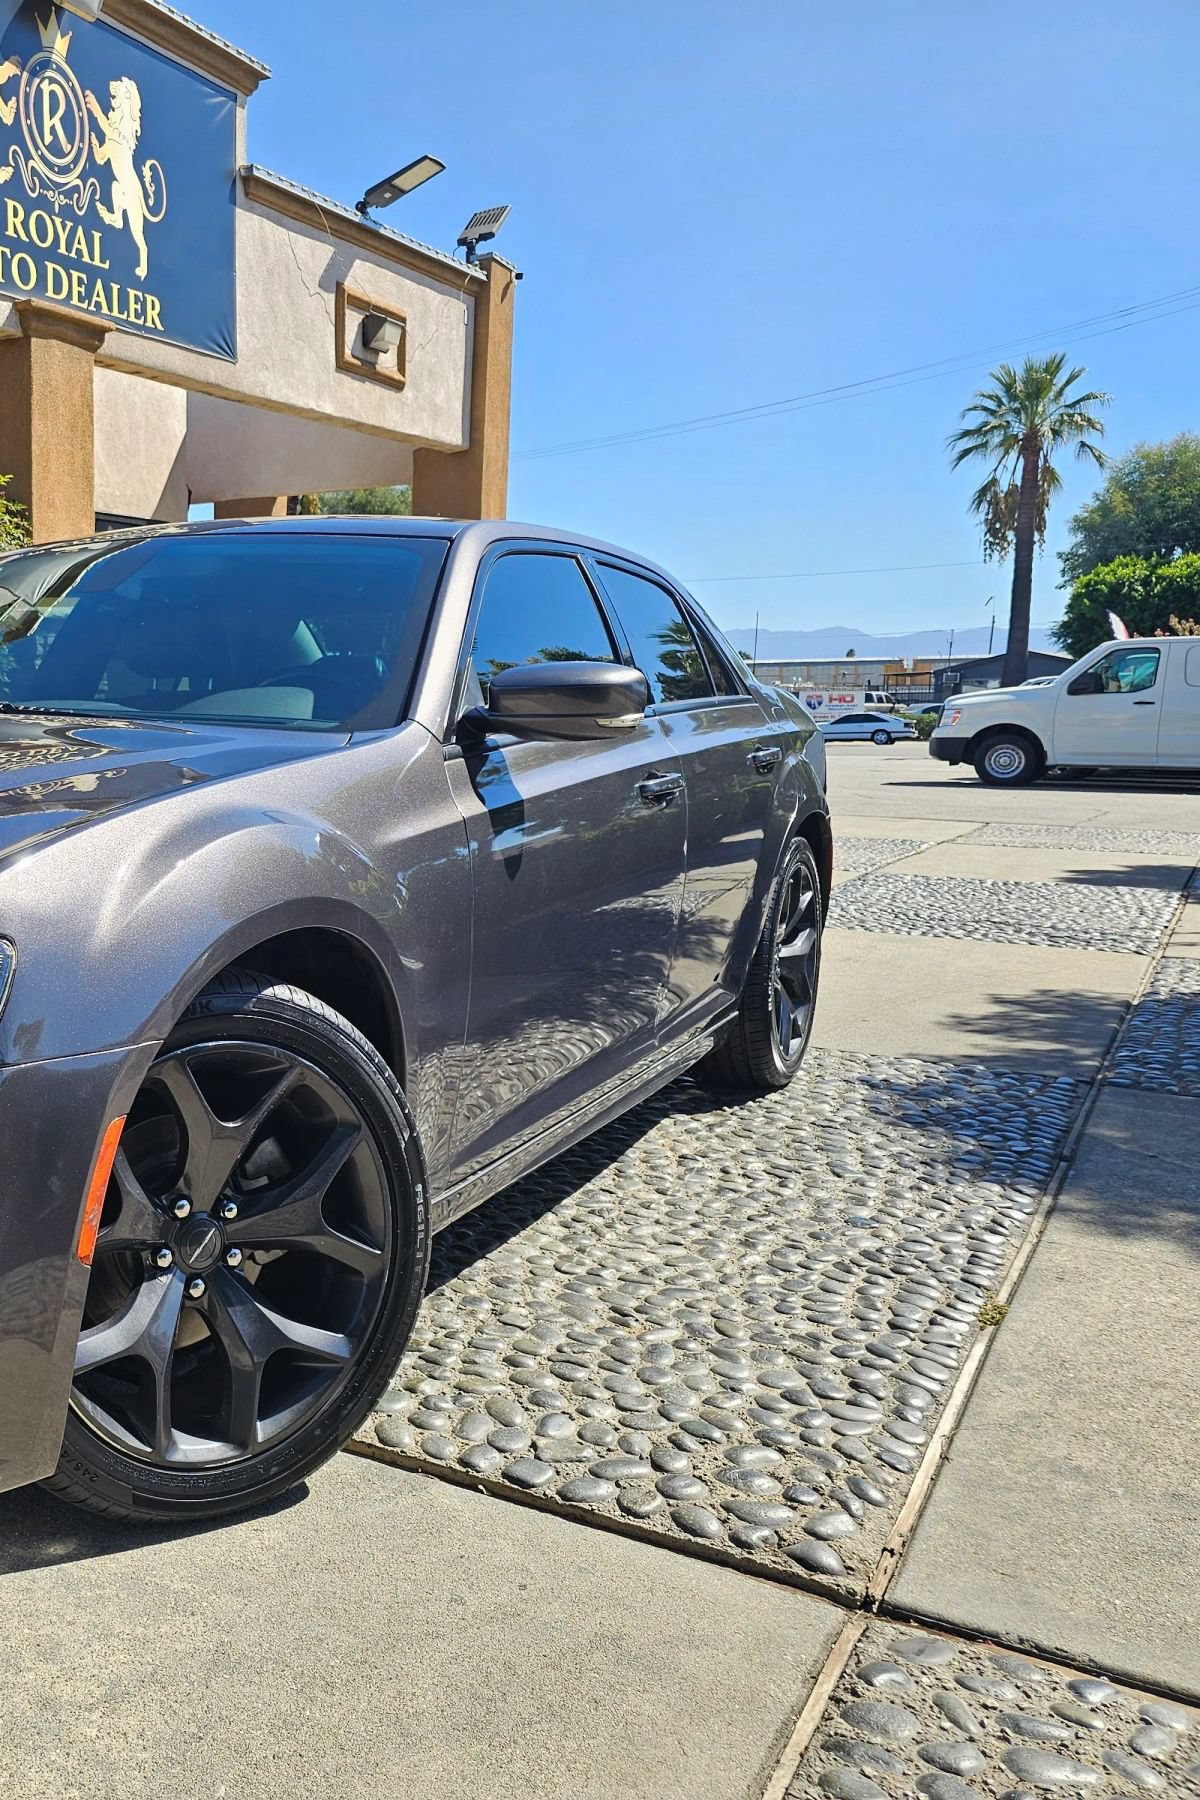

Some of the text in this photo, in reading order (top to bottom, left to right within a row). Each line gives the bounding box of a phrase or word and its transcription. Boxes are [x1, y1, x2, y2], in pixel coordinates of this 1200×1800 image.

[39, 78, 72, 155] R
[4, 197, 110, 270] ROYAL
[44, 260, 164, 332] DEALER
